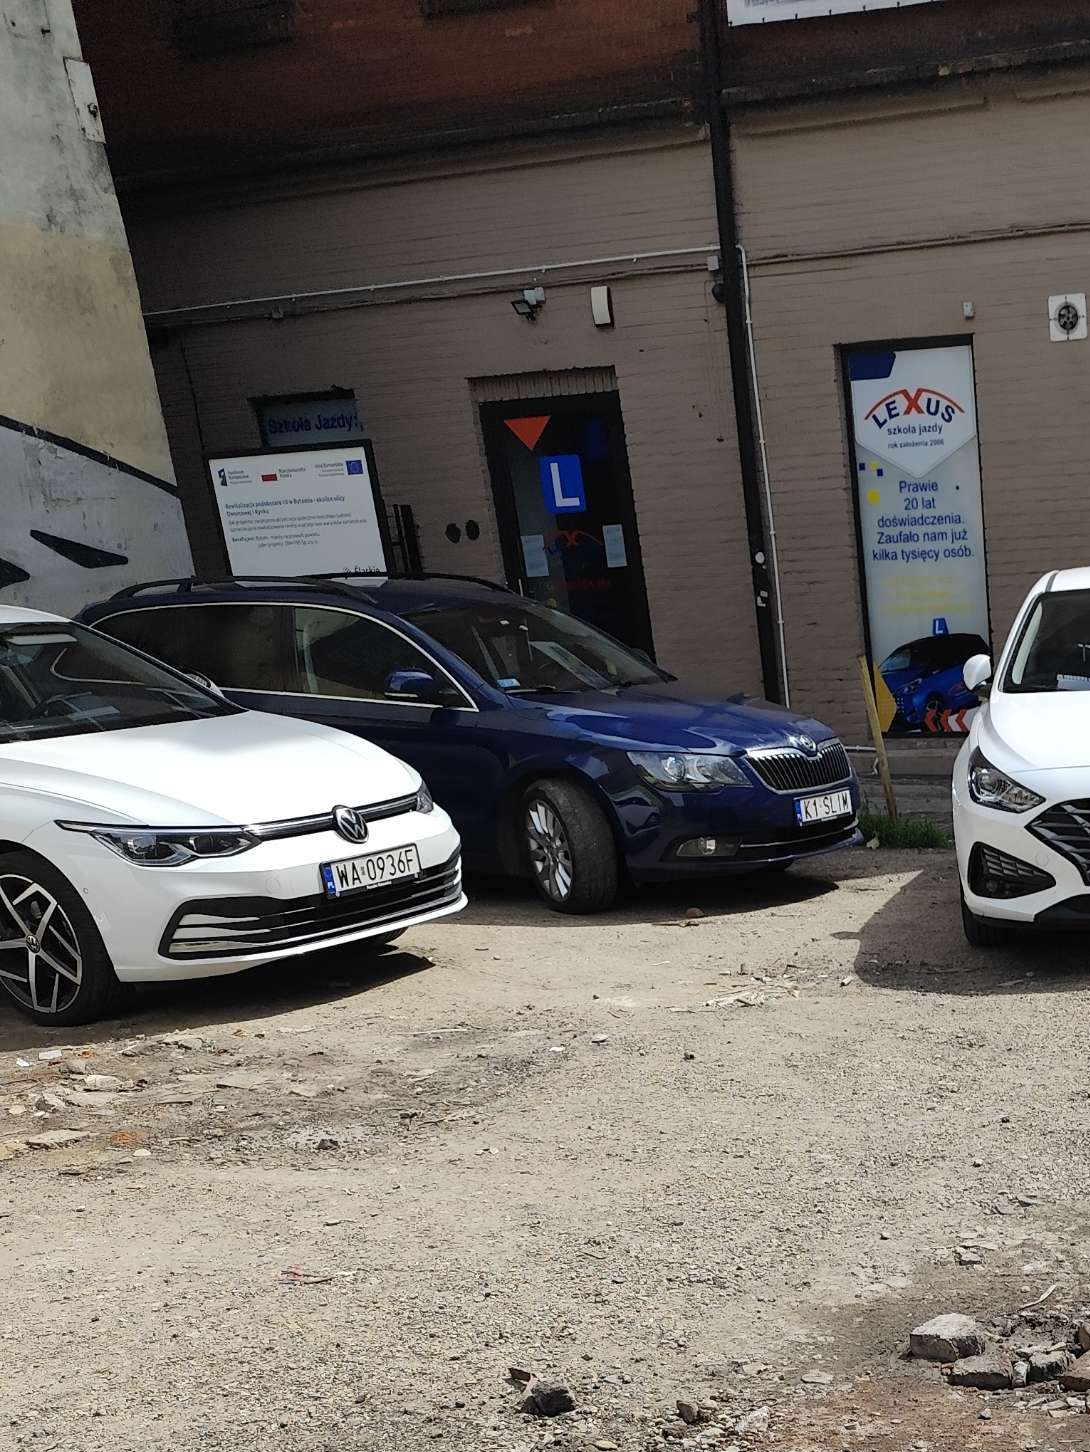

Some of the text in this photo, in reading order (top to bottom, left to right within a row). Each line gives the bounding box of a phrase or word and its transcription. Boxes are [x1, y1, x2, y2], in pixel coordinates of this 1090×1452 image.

[872, 388, 956, 430] LEXUS
[918, 422, 943, 436] jazdy
[550, 462, 581, 508] L
[899, 480, 939, 494] Prawie
[904, 496, 937, 511] 20 lat
[877, 513, 965, 529] doświadczenia.
[877, 528, 969, 545] Zaufało nam już
[872, 544, 975, 563] kilka tysięcy osób.
[822, 791, 849, 815] SLIM
[336, 848, 414, 889] WA 0936F
